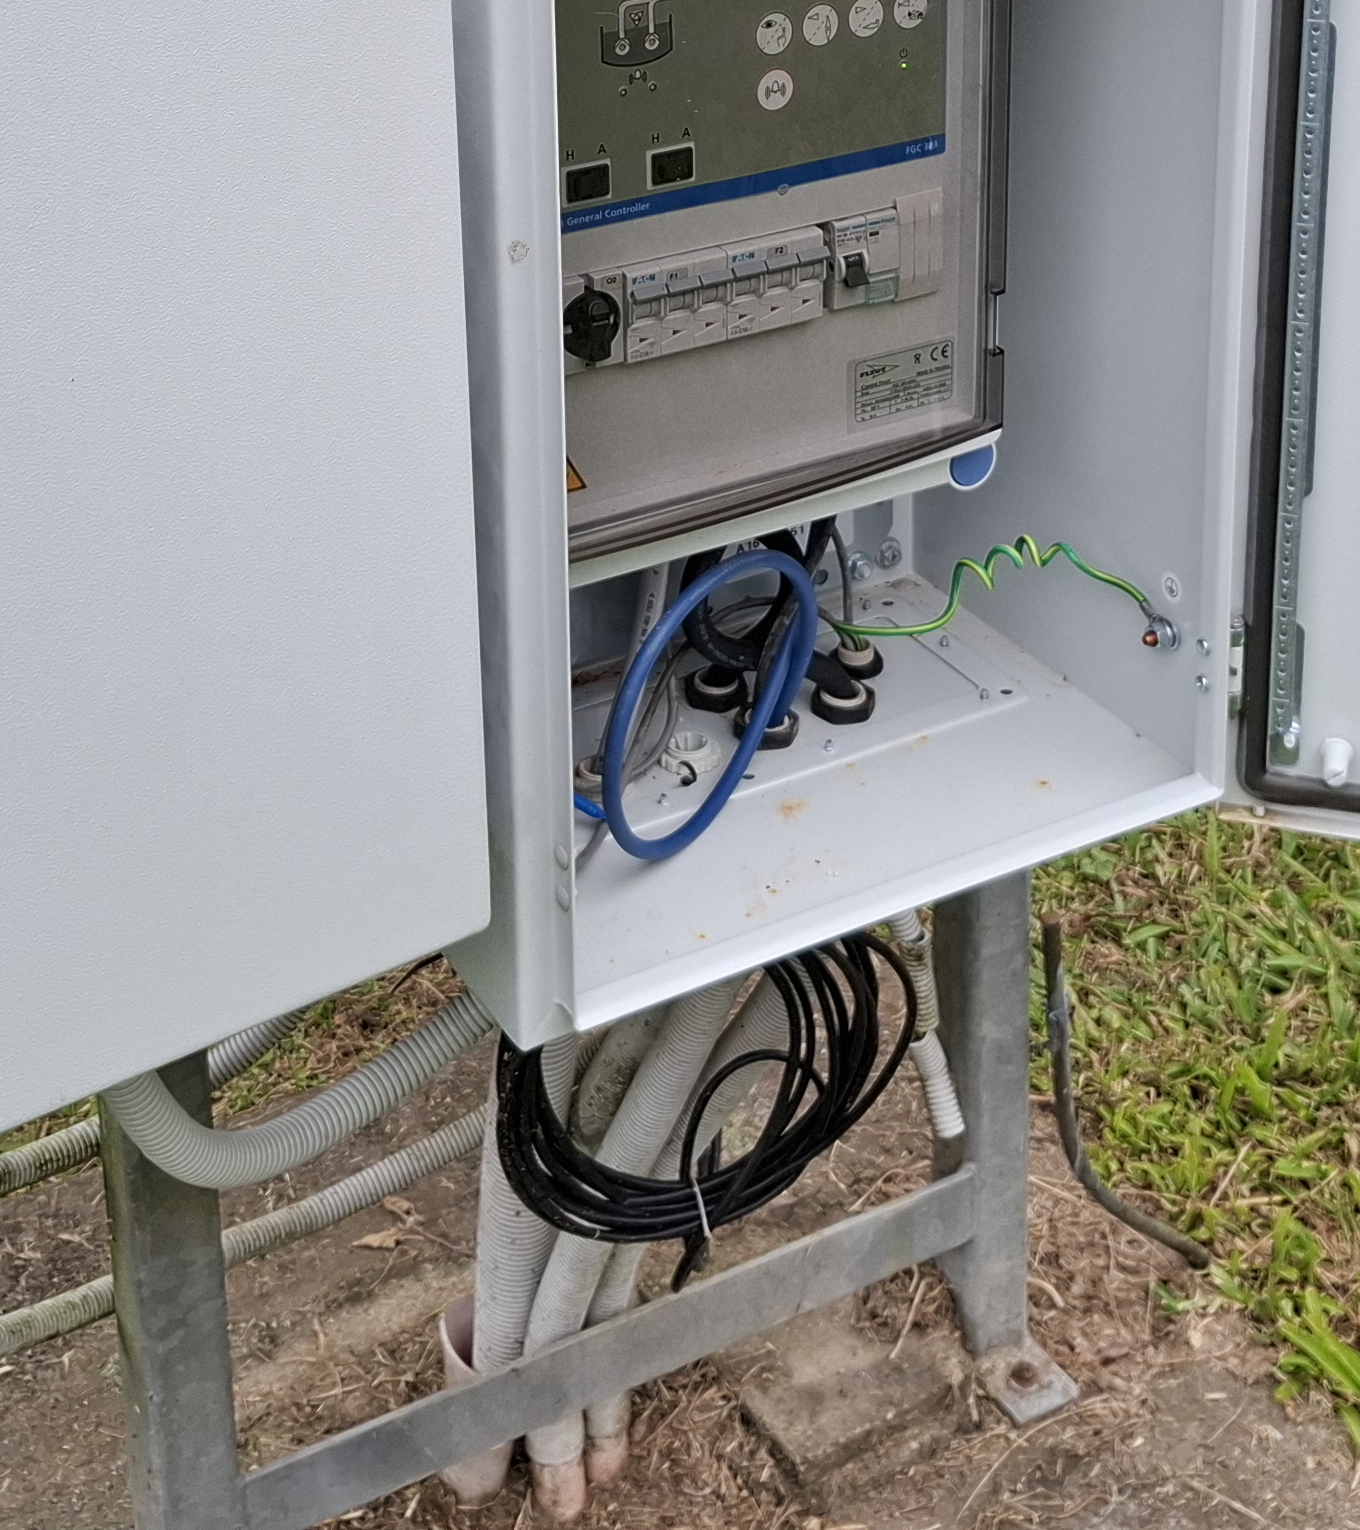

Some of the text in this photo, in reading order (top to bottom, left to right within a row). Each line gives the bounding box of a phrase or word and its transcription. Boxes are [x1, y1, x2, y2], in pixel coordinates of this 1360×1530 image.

[652, 127, 691, 144] H A
[566, 143, 607, 161] H A
[566, 202, 650, 226] General Controller
